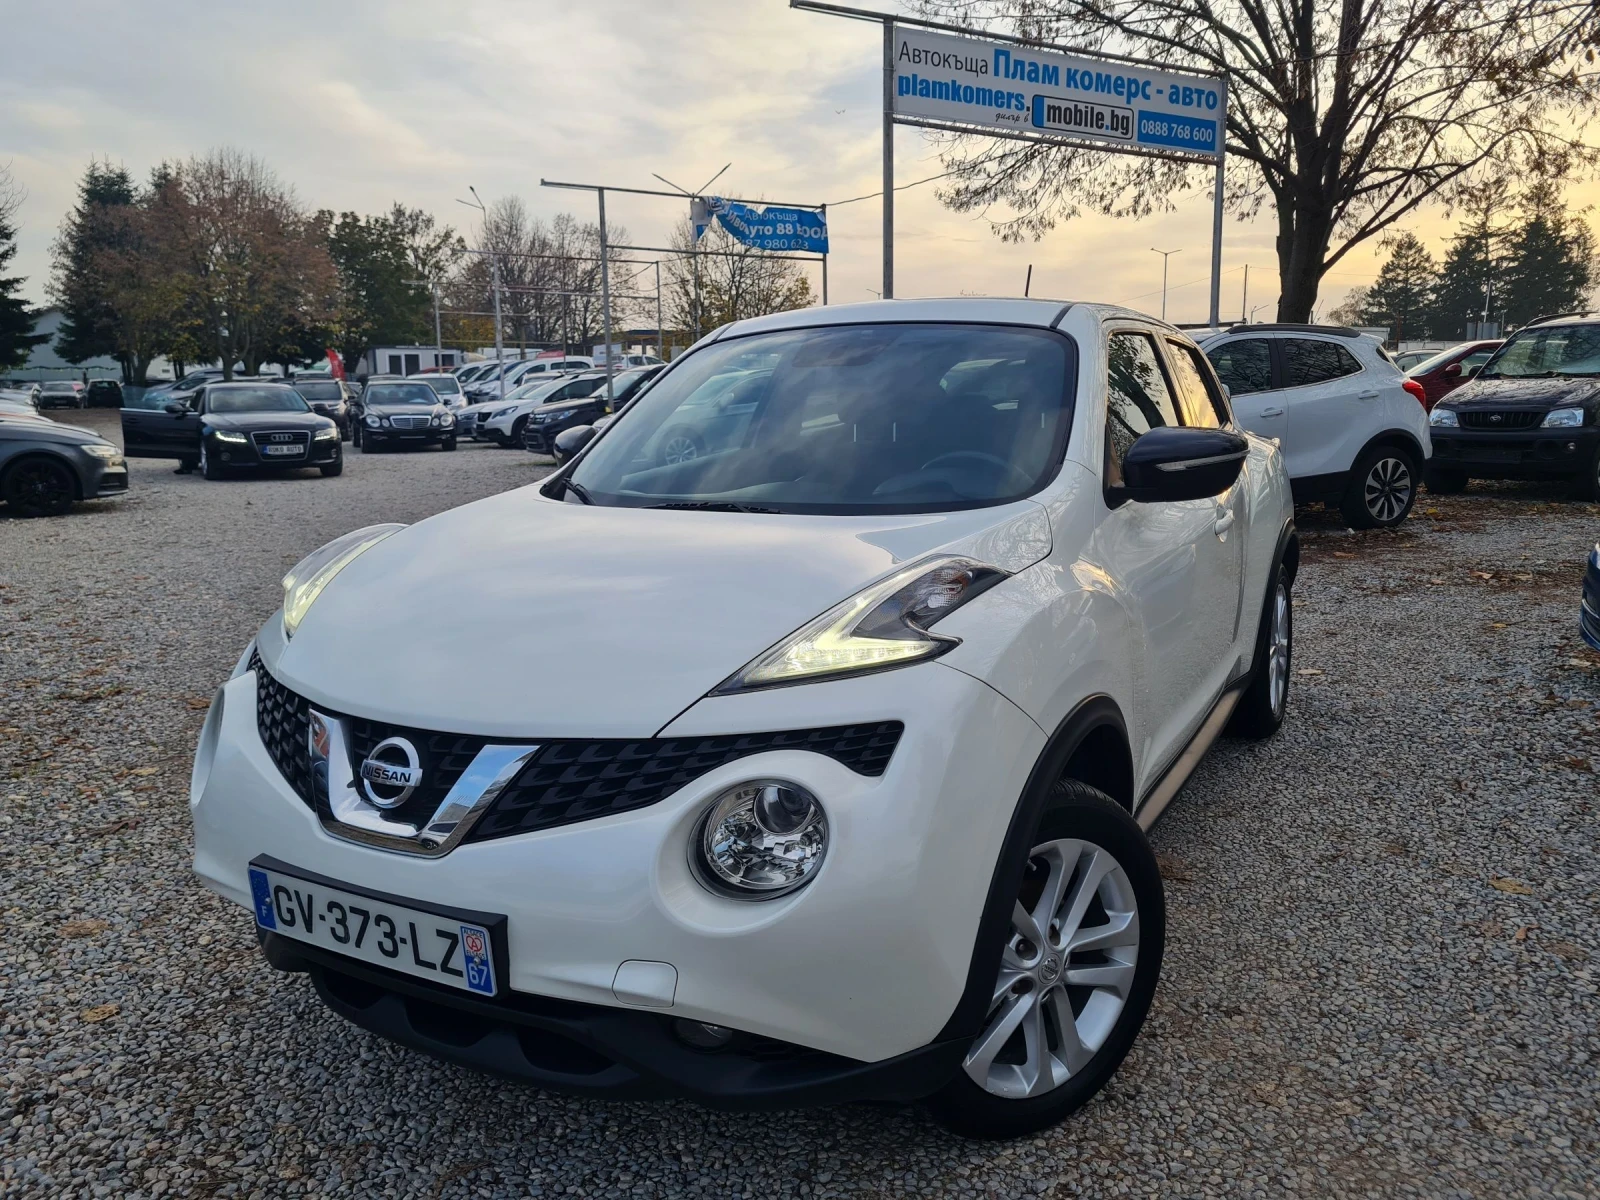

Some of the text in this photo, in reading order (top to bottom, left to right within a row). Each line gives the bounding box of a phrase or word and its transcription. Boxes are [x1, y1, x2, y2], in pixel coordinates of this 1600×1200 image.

[898, 40, 989, 78] Автокъща
[993, 48, 1060, 86] Плам
[1066, 67, 1152, 105] комерс
[1168, 84, 1218, 111] авто
[1046, 104, 1130, 136] mobile.bg
[1141, 119, 1213, 143] 0888 768 600
[776, 222, 794, 235] 88
[764, 239, 788, 249] 980
[791, 239, 809, 250] 623
[364, 765, 411, 783] NISSAN
[261, 905, 268, 917] F
[274, 885, 464, 977] GV-373-LZ
[468, 962, 488, 986] 67
